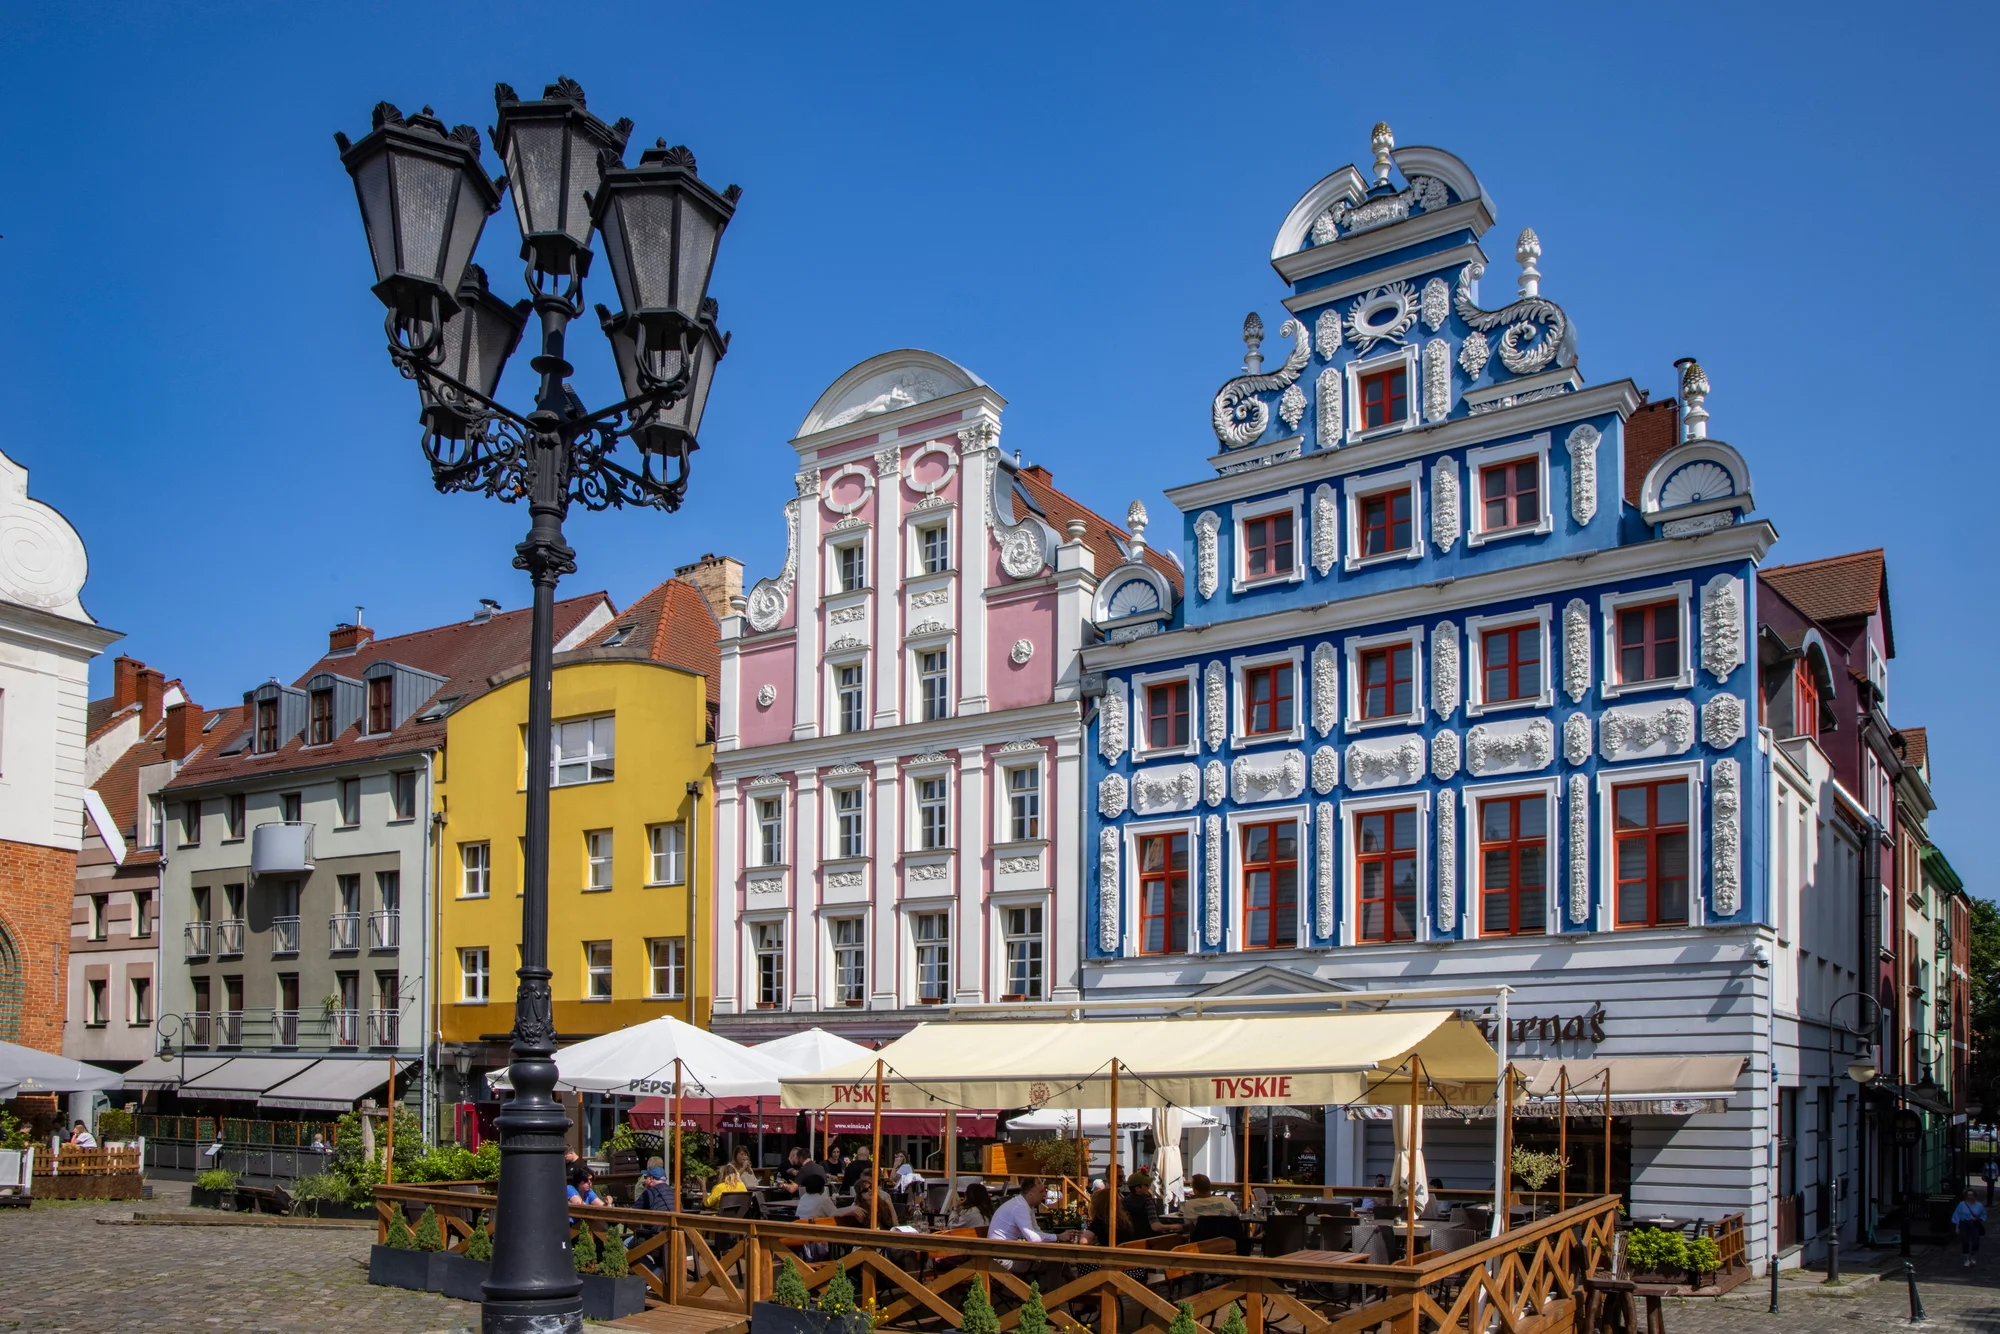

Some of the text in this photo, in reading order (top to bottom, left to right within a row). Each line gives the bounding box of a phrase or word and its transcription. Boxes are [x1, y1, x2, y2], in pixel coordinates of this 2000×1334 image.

[1478, 999, 1606, 1047] arnaś
[831, 1085, 891, 1103] TYSKE
[1211, 1076, 1293, 1099] TYSKIE
[653, 1118, 660, 1127] La
